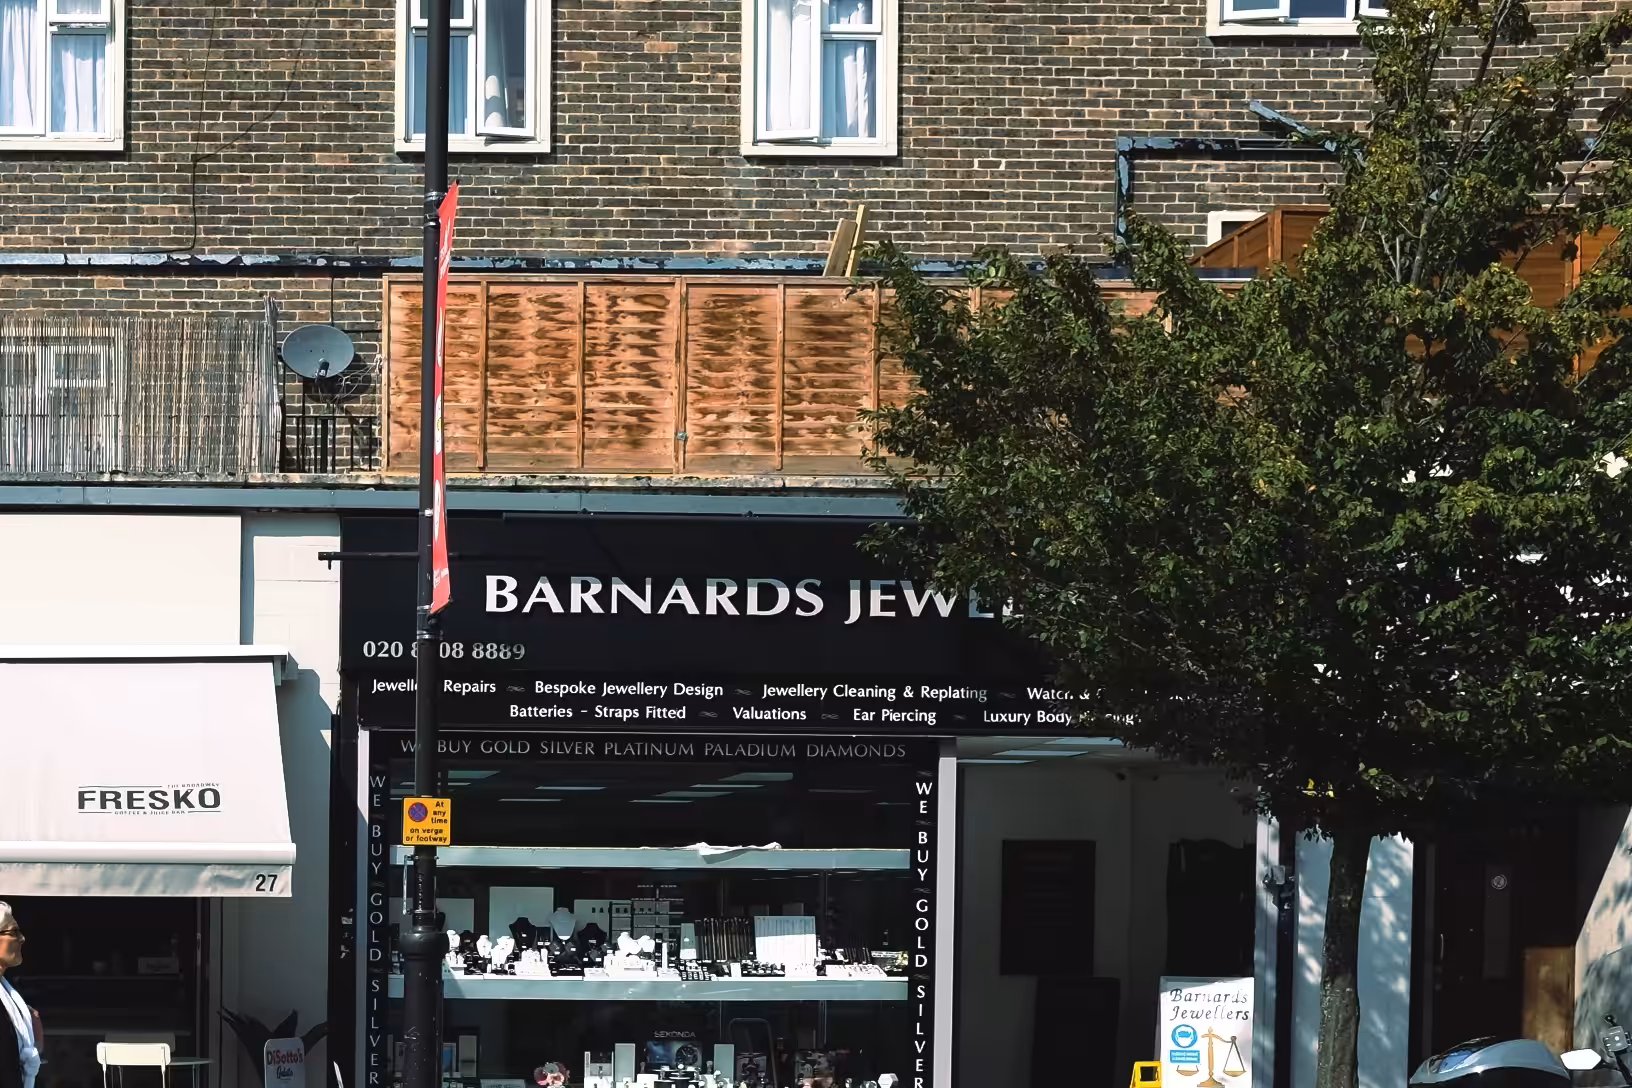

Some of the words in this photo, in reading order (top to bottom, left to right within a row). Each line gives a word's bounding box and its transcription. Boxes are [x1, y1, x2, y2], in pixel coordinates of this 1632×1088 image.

[484, 574, 825, 618] BARNARDS
[362, 640, 404, 659] 020
[410, 640, 465, 660] 808
[471, 642, 526, 660] 8889
[443, 679, 497, 696] Repairs
[534, 680, 596, 697] Bespoke
[602, 680, 667, 699] Jewellery
[673, 682, 724, 700] Design
[762, 683, 828, 701] Jewellery
[833, 684, 897, 702] Cleaning
[902, 685, 914, 699] &
[920, 685, 988, 703] Replating
[509, 703, 573, 719] Batteries
[594, 704, 640, 721] Straps
[645, 704, 687, 720] Fitted
[732, 707, 807, 721] Valuations
[852, 708, 875, 722] Ear
[881, 708, 937, 725] Piercing
[983, 709, 1031, 727] Luxury
[1036, 710, 1073, 727] Body
[437, 739, 472, 754] BUY
[480, 740, 531, 755] GOLD
[539, 740, 595, 756] SILVER
[604, 741, 694, 757] PLATINUM
[704, 742, 797, 758] PALADIUM
[807, 743, 906, 759] DIAMONDS
[78, 787, 222, 809] FRESKO
[369, 775, 386, 807] WE
[915, 781, 933, 815] WE
[369, 824, 384, 876] BUY
[416, 834, 448, 843] footway
[917, 830, 929, 883] BUY
[255, 873, 278, 892] 27
[369, 892, 384, 962] GOLD
[915, 898, 929, 969] GOLD
[1169, 988, 1248, 1004] Barnards
[1169, 1005, 1250, 1021] Jewellers
[368, 978, 381, 1086] SILVER
[654, 1030, 696, 1038] SEKONDA
[266, 1048, 303, 1066] DiSotto's
